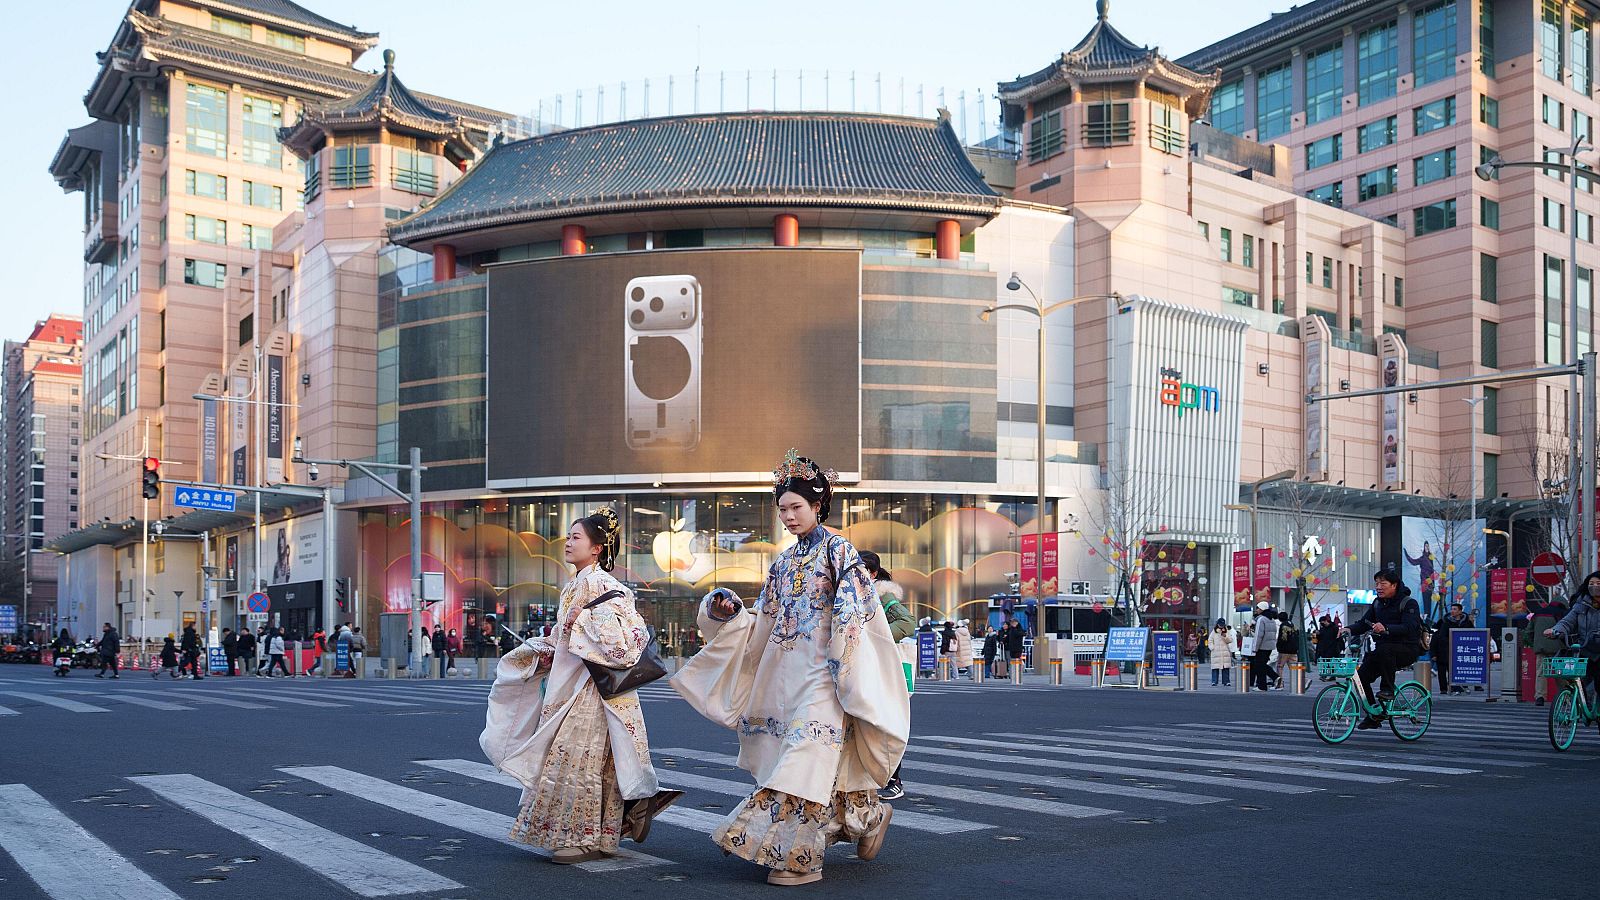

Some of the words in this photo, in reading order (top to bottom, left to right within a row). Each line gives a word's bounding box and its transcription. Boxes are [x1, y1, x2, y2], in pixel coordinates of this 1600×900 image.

[1161, 379, 1219, 417] apm
[205, 416, 216, 461] HOLLISTER
[271, 424, 280, 443] Fitch
[192, 491, 233, 503] 金鱼胡同
[1457, 655, 1484, 663] 车辆通行
